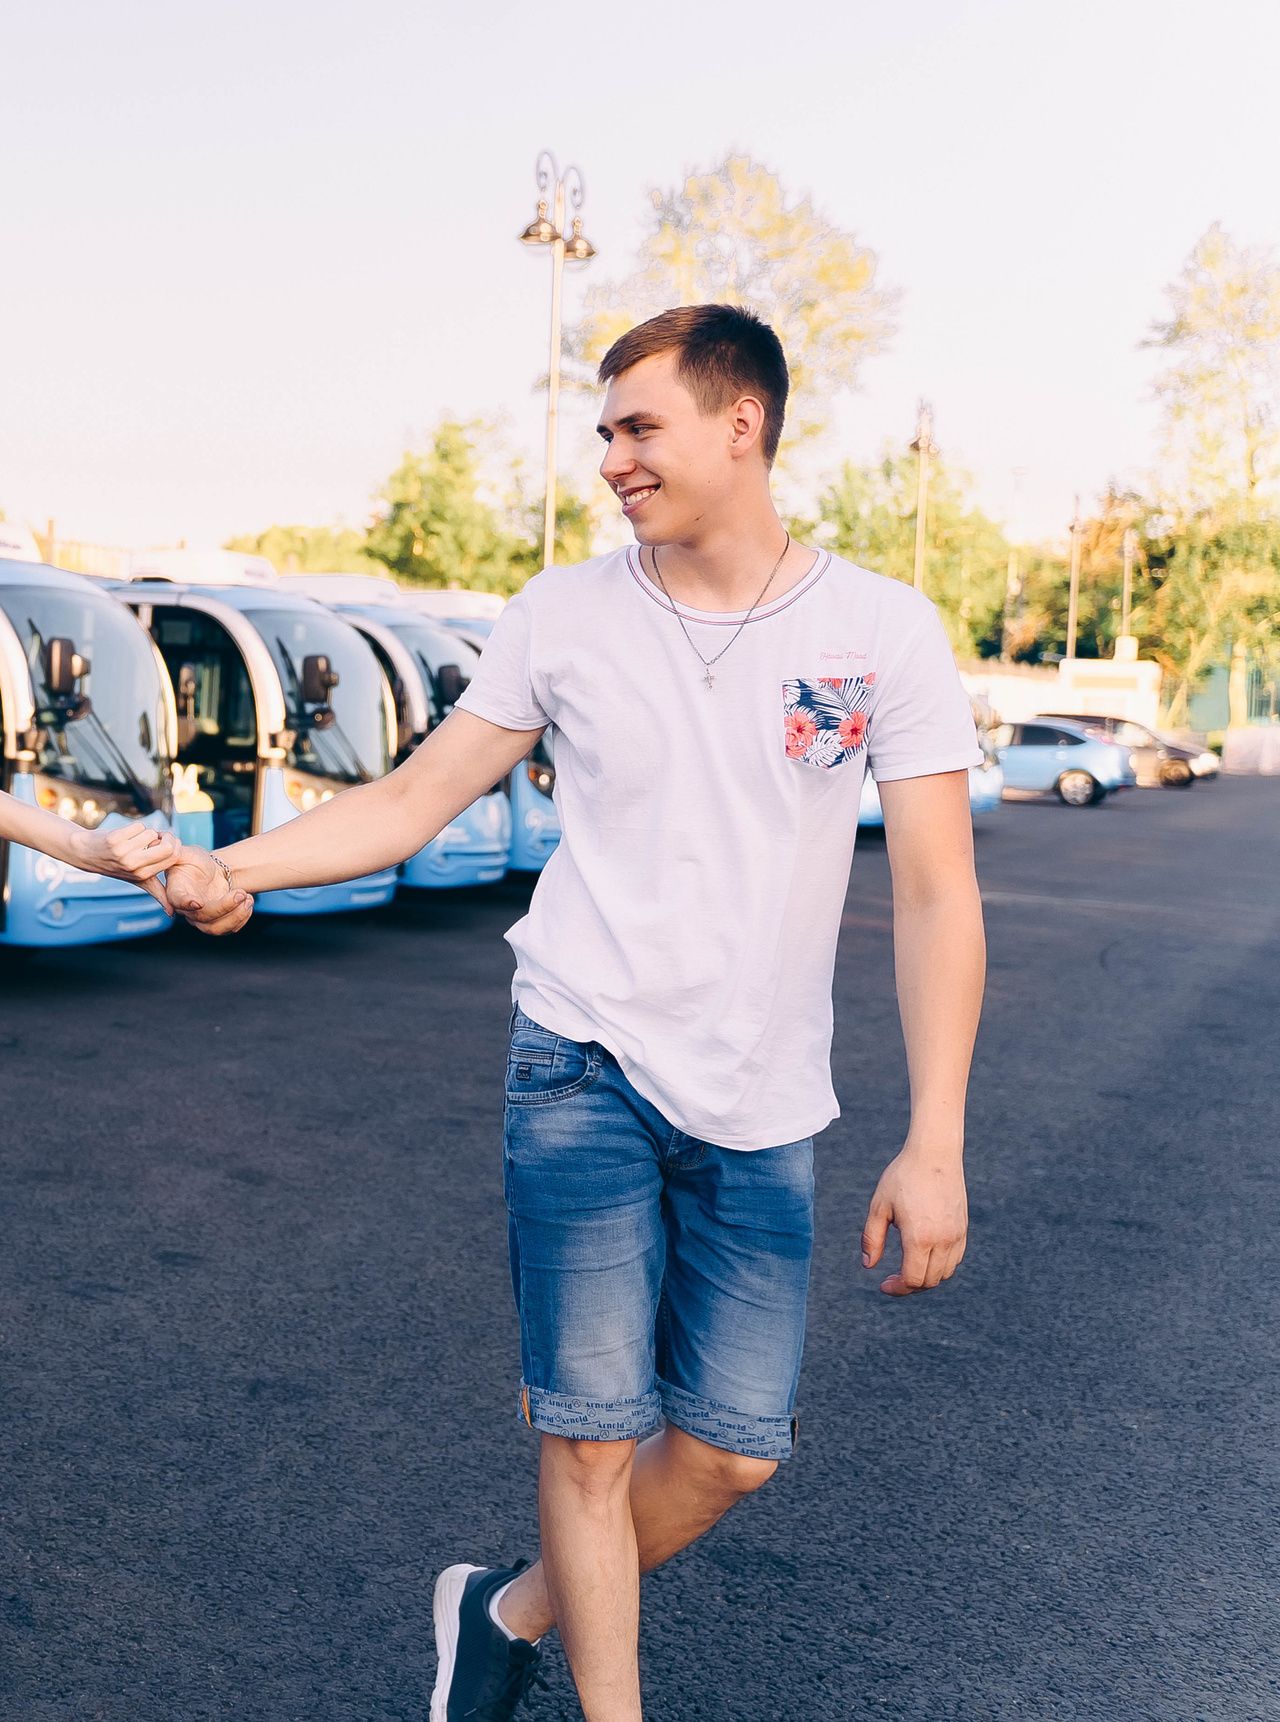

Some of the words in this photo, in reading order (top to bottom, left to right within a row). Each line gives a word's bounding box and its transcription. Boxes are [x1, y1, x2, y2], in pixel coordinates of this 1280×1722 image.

[548, 1399, 573, 1409] Arnold
[585, 1401, 614, 1409] Arnold
[560, 1415, 588, 1424] Arnold
[597, 1421, 625, 1429] Arnold
[716, 1419, 747, 1431] Arnold
[571, 1431, 600, 1441] Arnold
[737, 1435, 766, 1444] Arnold
[740, 1447, 769, 1457] Arnold
